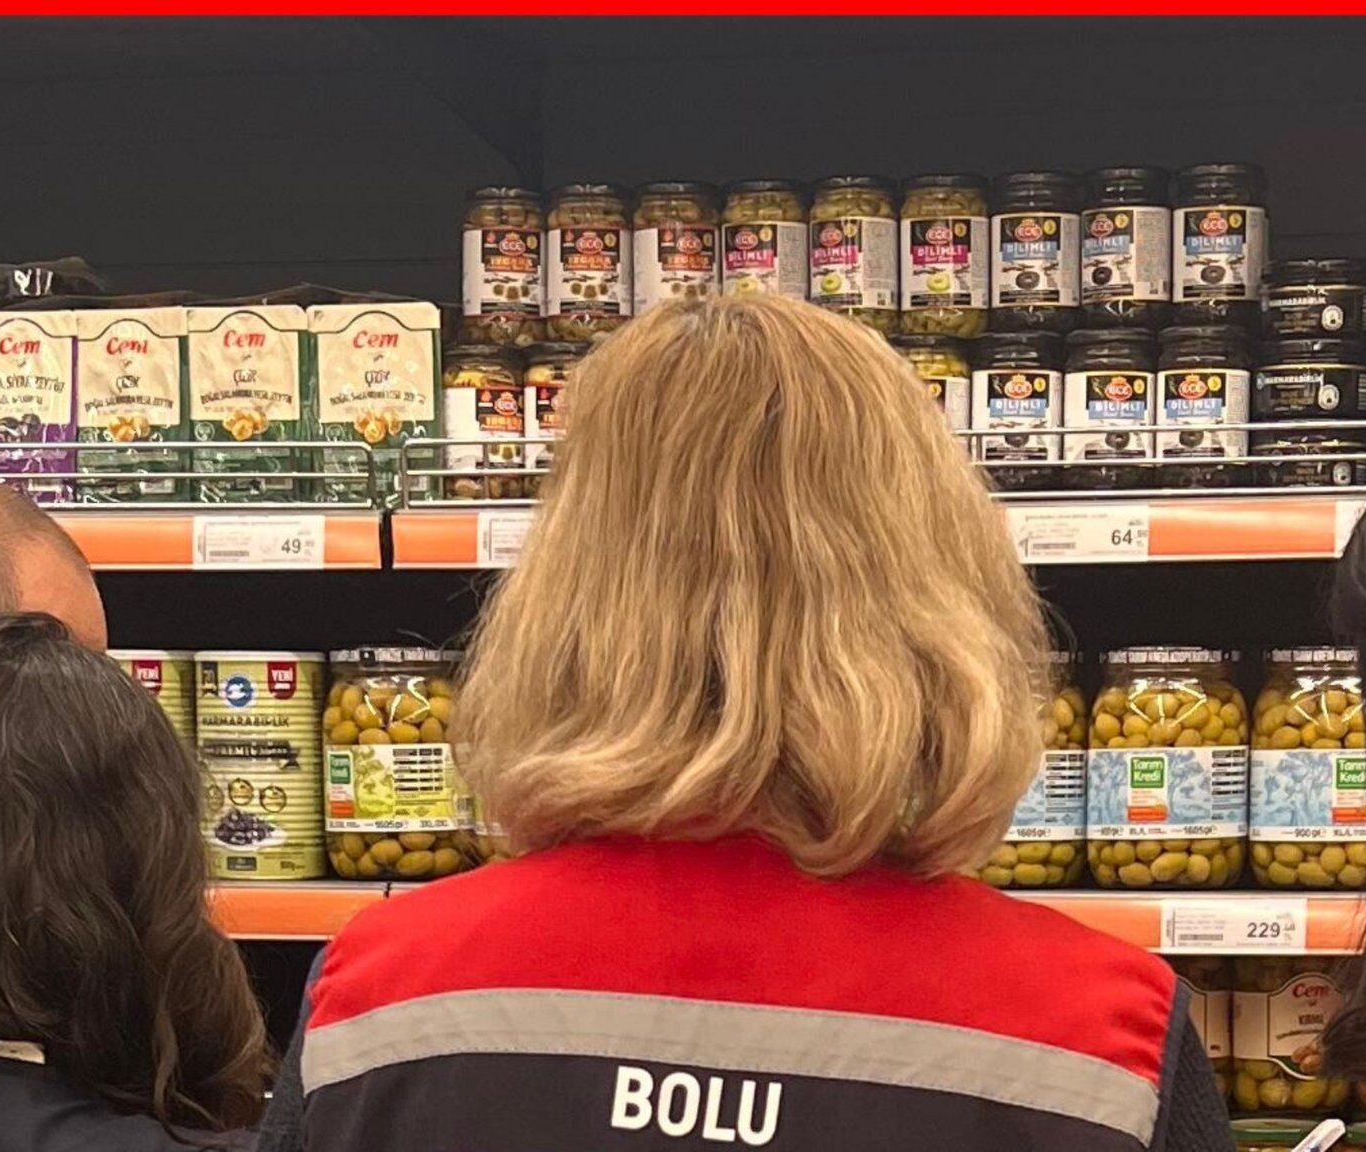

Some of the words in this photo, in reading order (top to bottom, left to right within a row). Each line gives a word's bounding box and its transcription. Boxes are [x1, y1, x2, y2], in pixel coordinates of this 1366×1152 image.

[223, 329, 266, 348] Cem
[353, 330, 399, 348] Cem
[1111, 529, 1132, 545] 64
[1246, 922, 1280, 938] 229
[1293, 984, 1329, 999] Cem
[610, 1065, 782, 1146] BOLU
